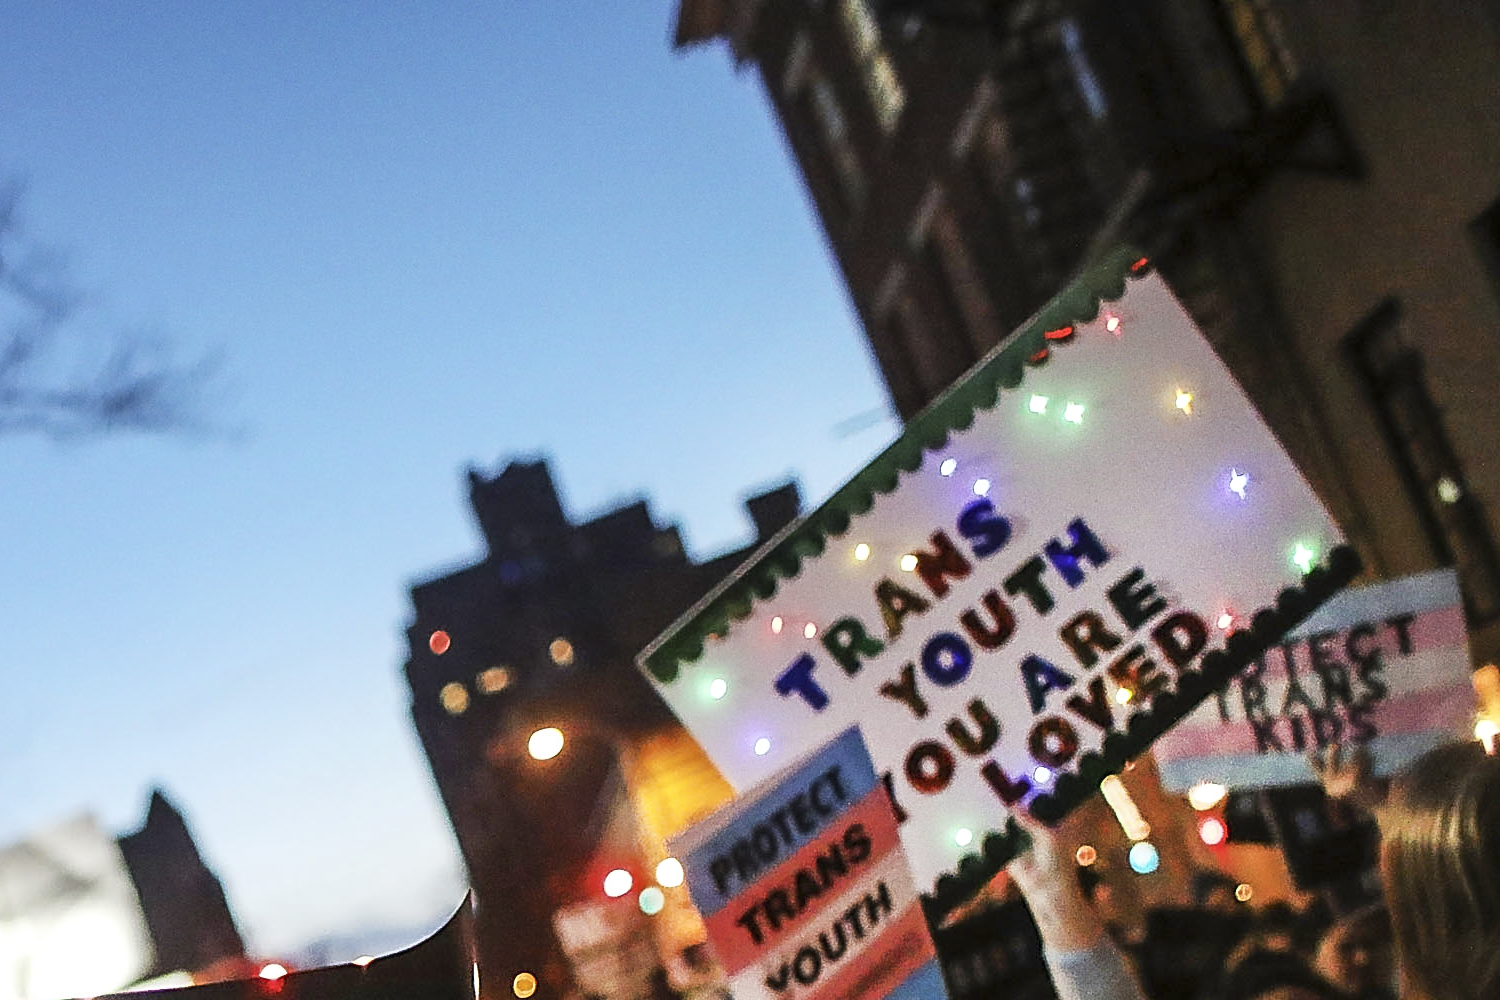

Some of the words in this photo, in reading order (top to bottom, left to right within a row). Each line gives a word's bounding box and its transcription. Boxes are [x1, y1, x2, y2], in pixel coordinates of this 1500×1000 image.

[774, 498, 1012, 712] TRANS
[879, 517, 1112, 718] YOUTH
[1020, 566, 1167, 714] ARE
[1250, 612, 1414, 684] TECT
[979, 609, 1209, 806] LOVED
[708, 765, 847, 895] PROTECT
[737, 823, 873, 945] TRANS
[765, 881, 893, 992] YOUTH
